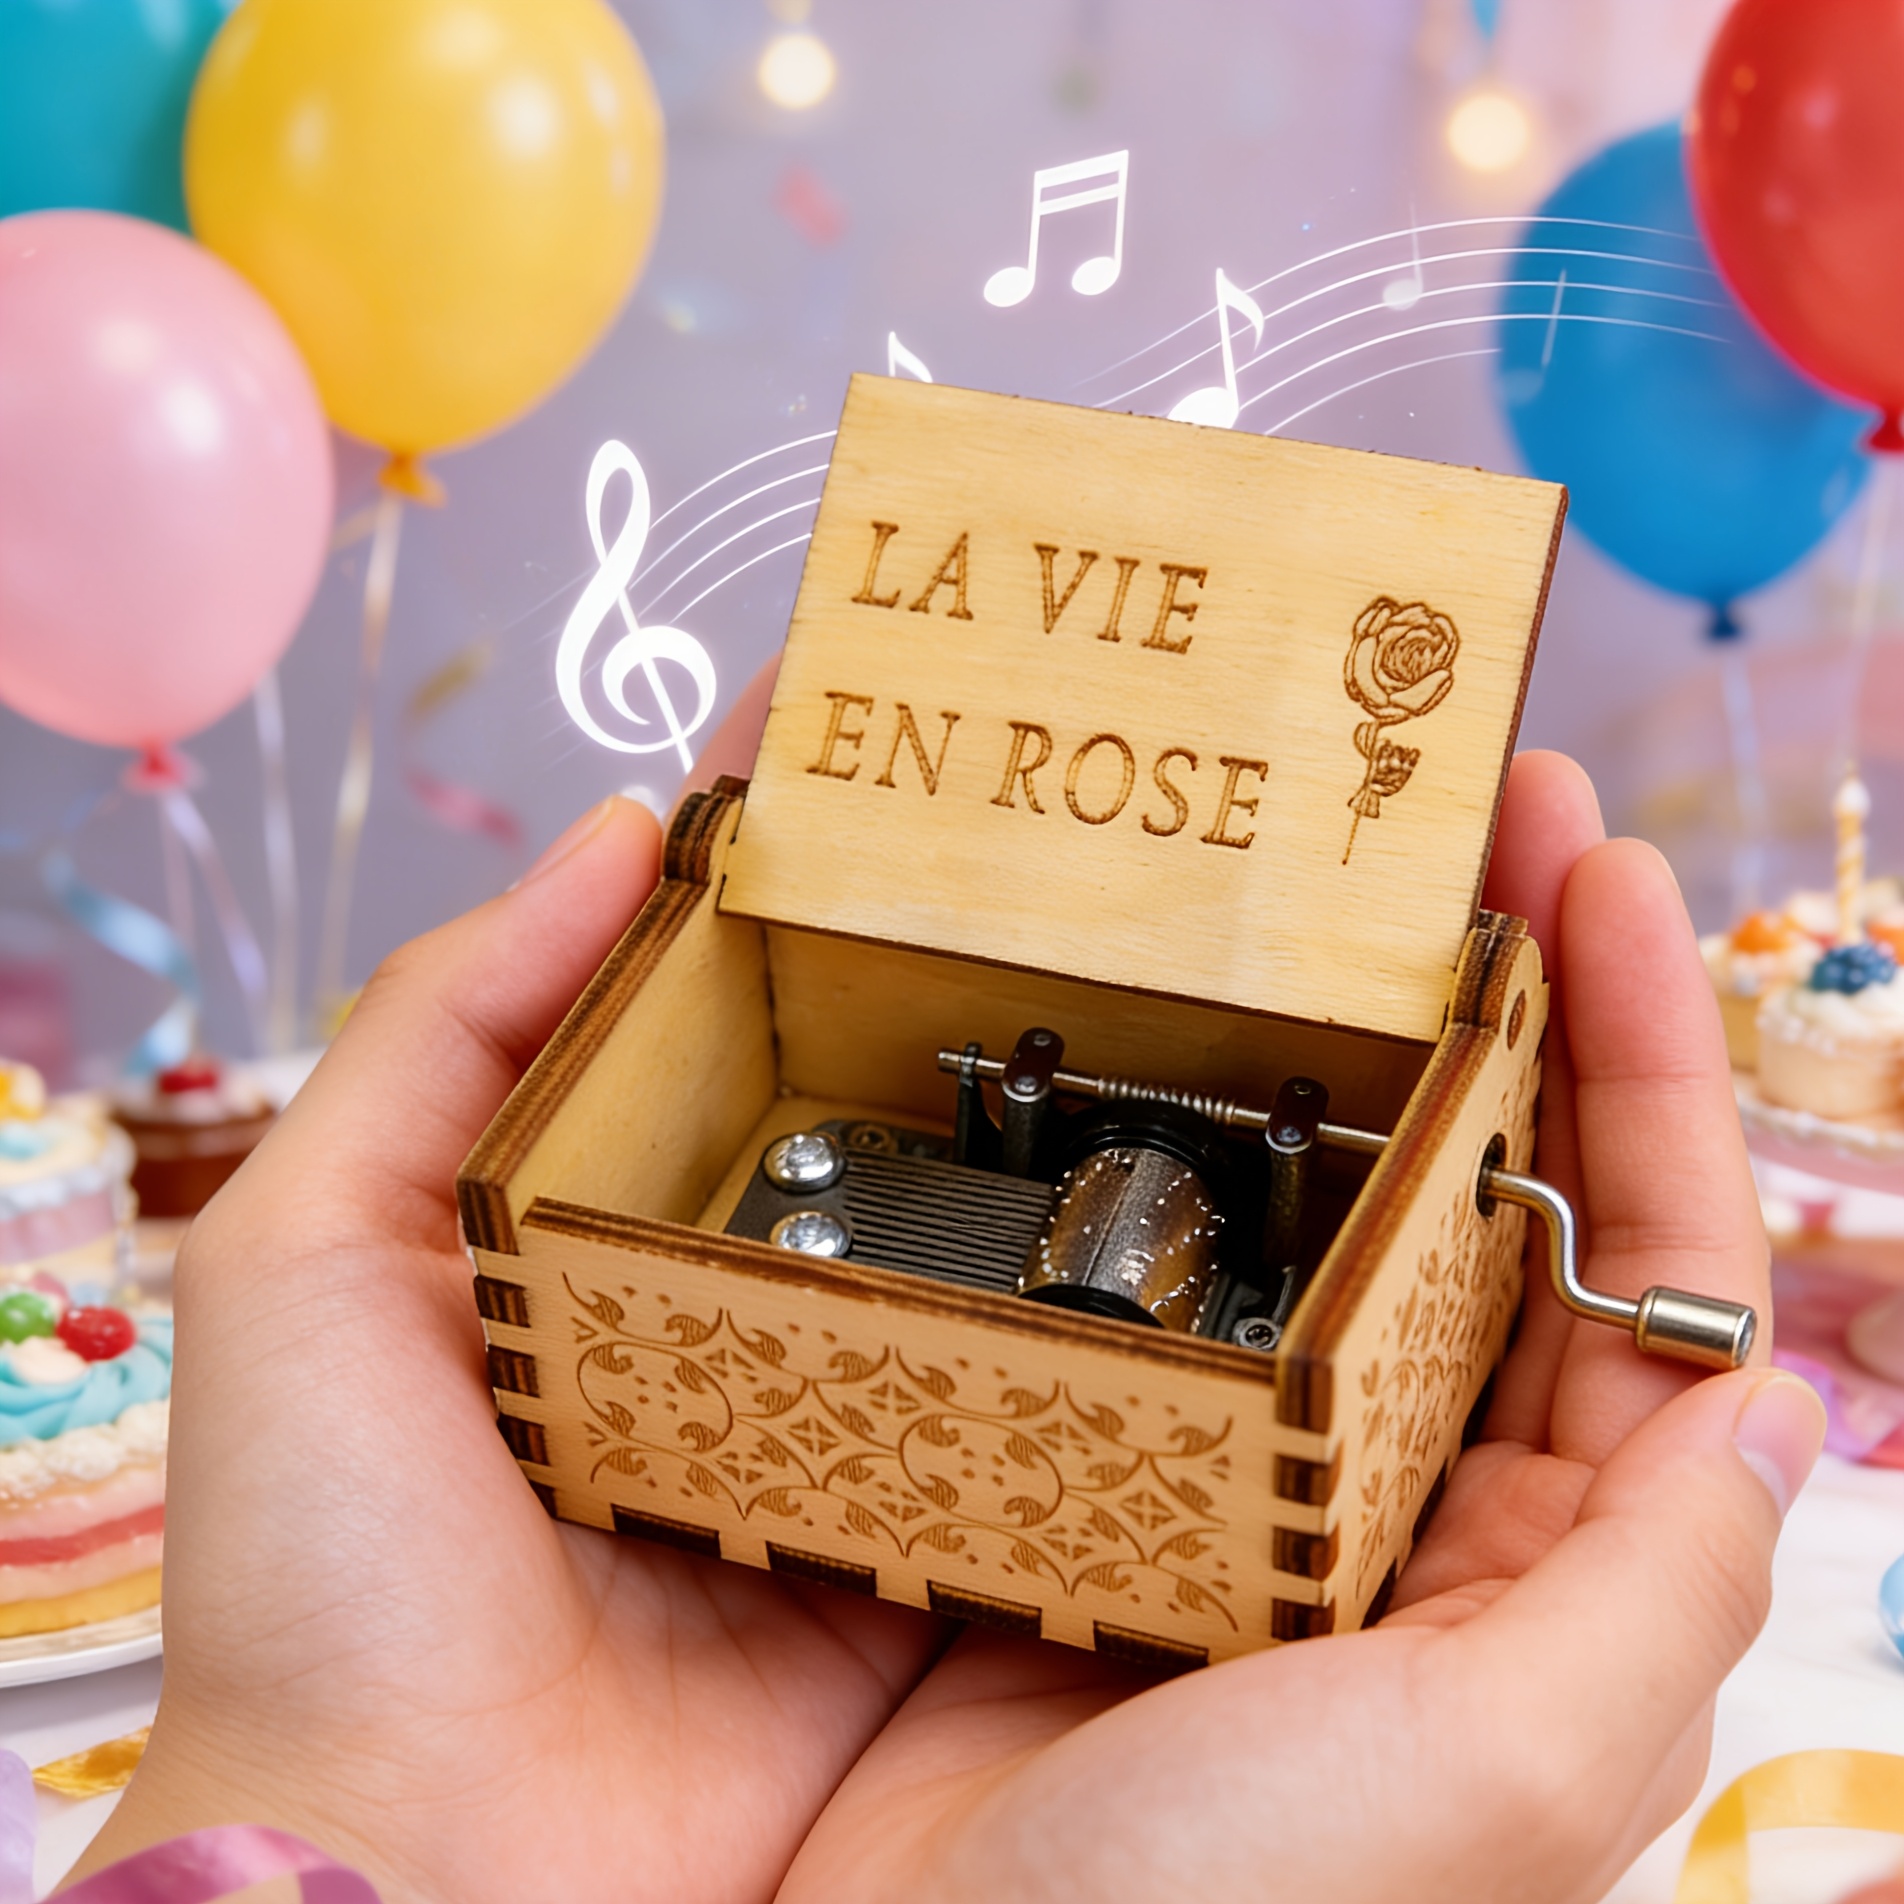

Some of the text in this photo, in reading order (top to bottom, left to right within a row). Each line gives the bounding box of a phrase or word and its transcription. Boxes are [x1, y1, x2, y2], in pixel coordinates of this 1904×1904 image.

[850, 520, 1208, 655] LA VIE
[805, 690, 1270, 850] EN ROSE
